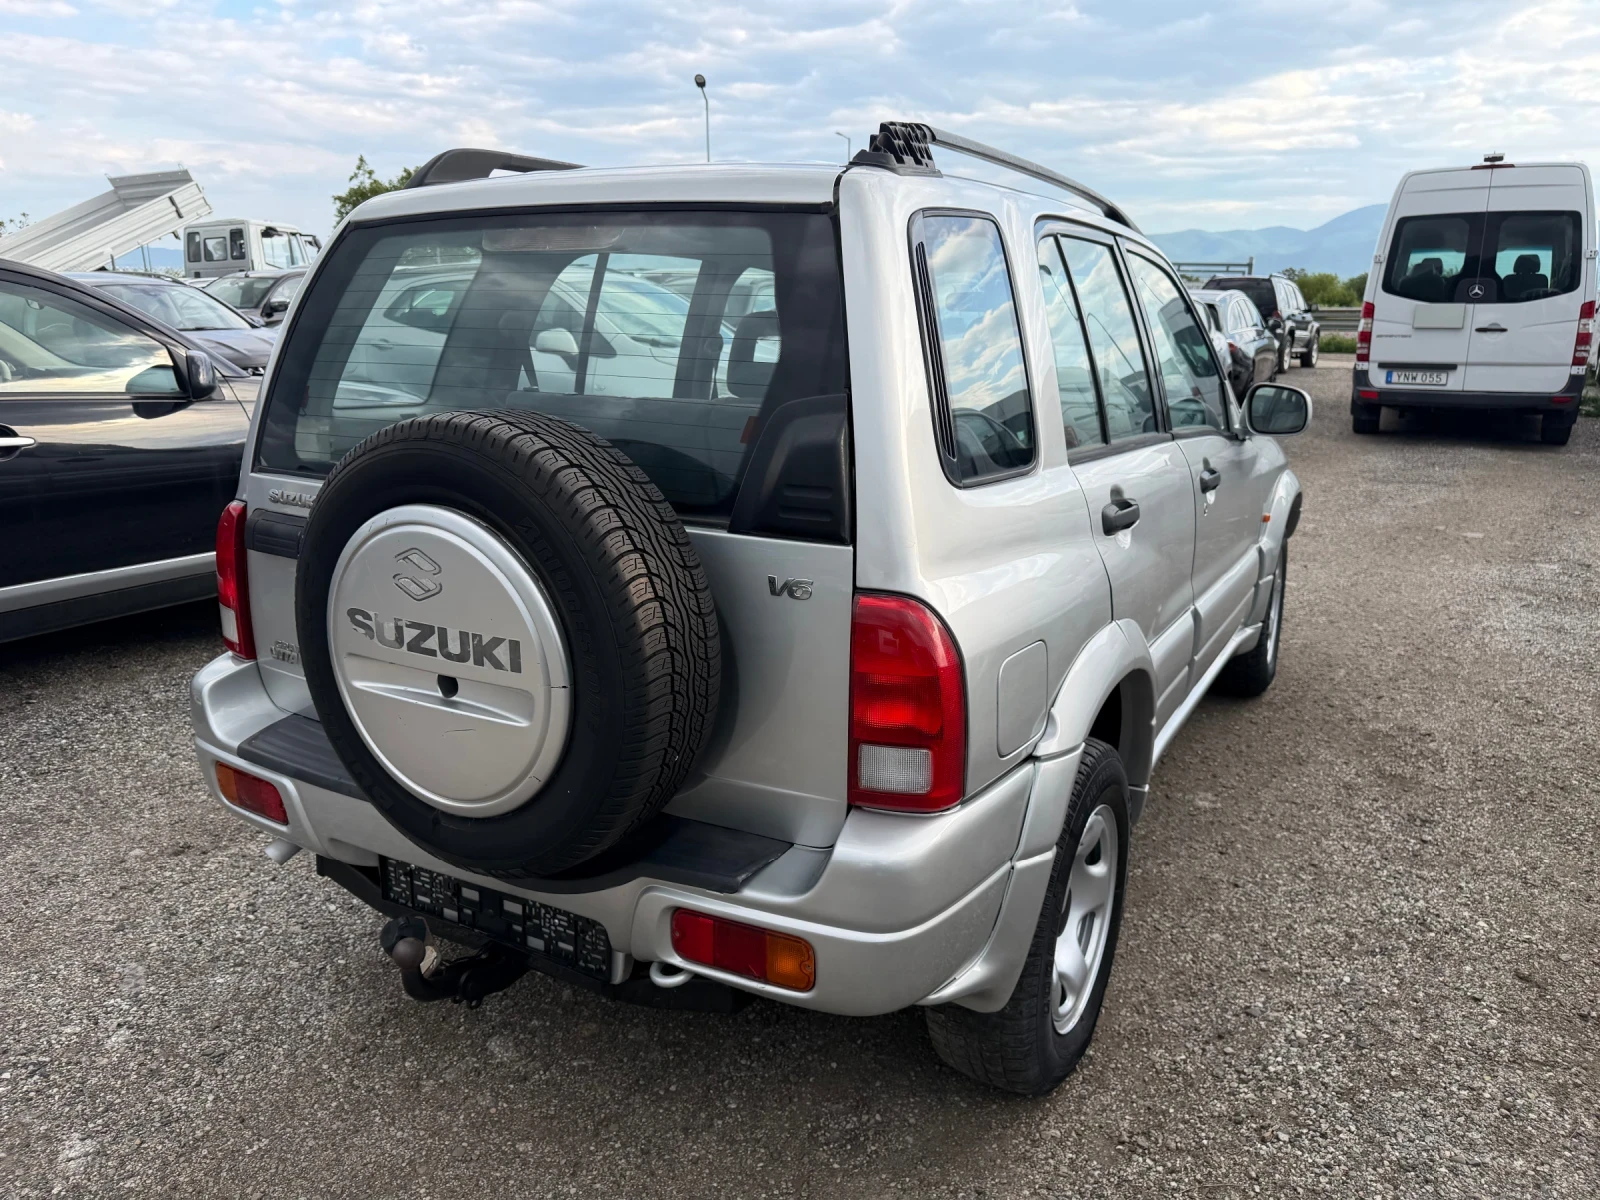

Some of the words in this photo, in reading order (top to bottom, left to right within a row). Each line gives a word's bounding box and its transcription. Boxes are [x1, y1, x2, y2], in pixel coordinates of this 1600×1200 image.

[1397, 372, 1418, 382] YNW
[1421, 373, 1442, 383] 055
[767, 574, 814, 601] V6
[346, 607, 522, 674] SUZUKI
